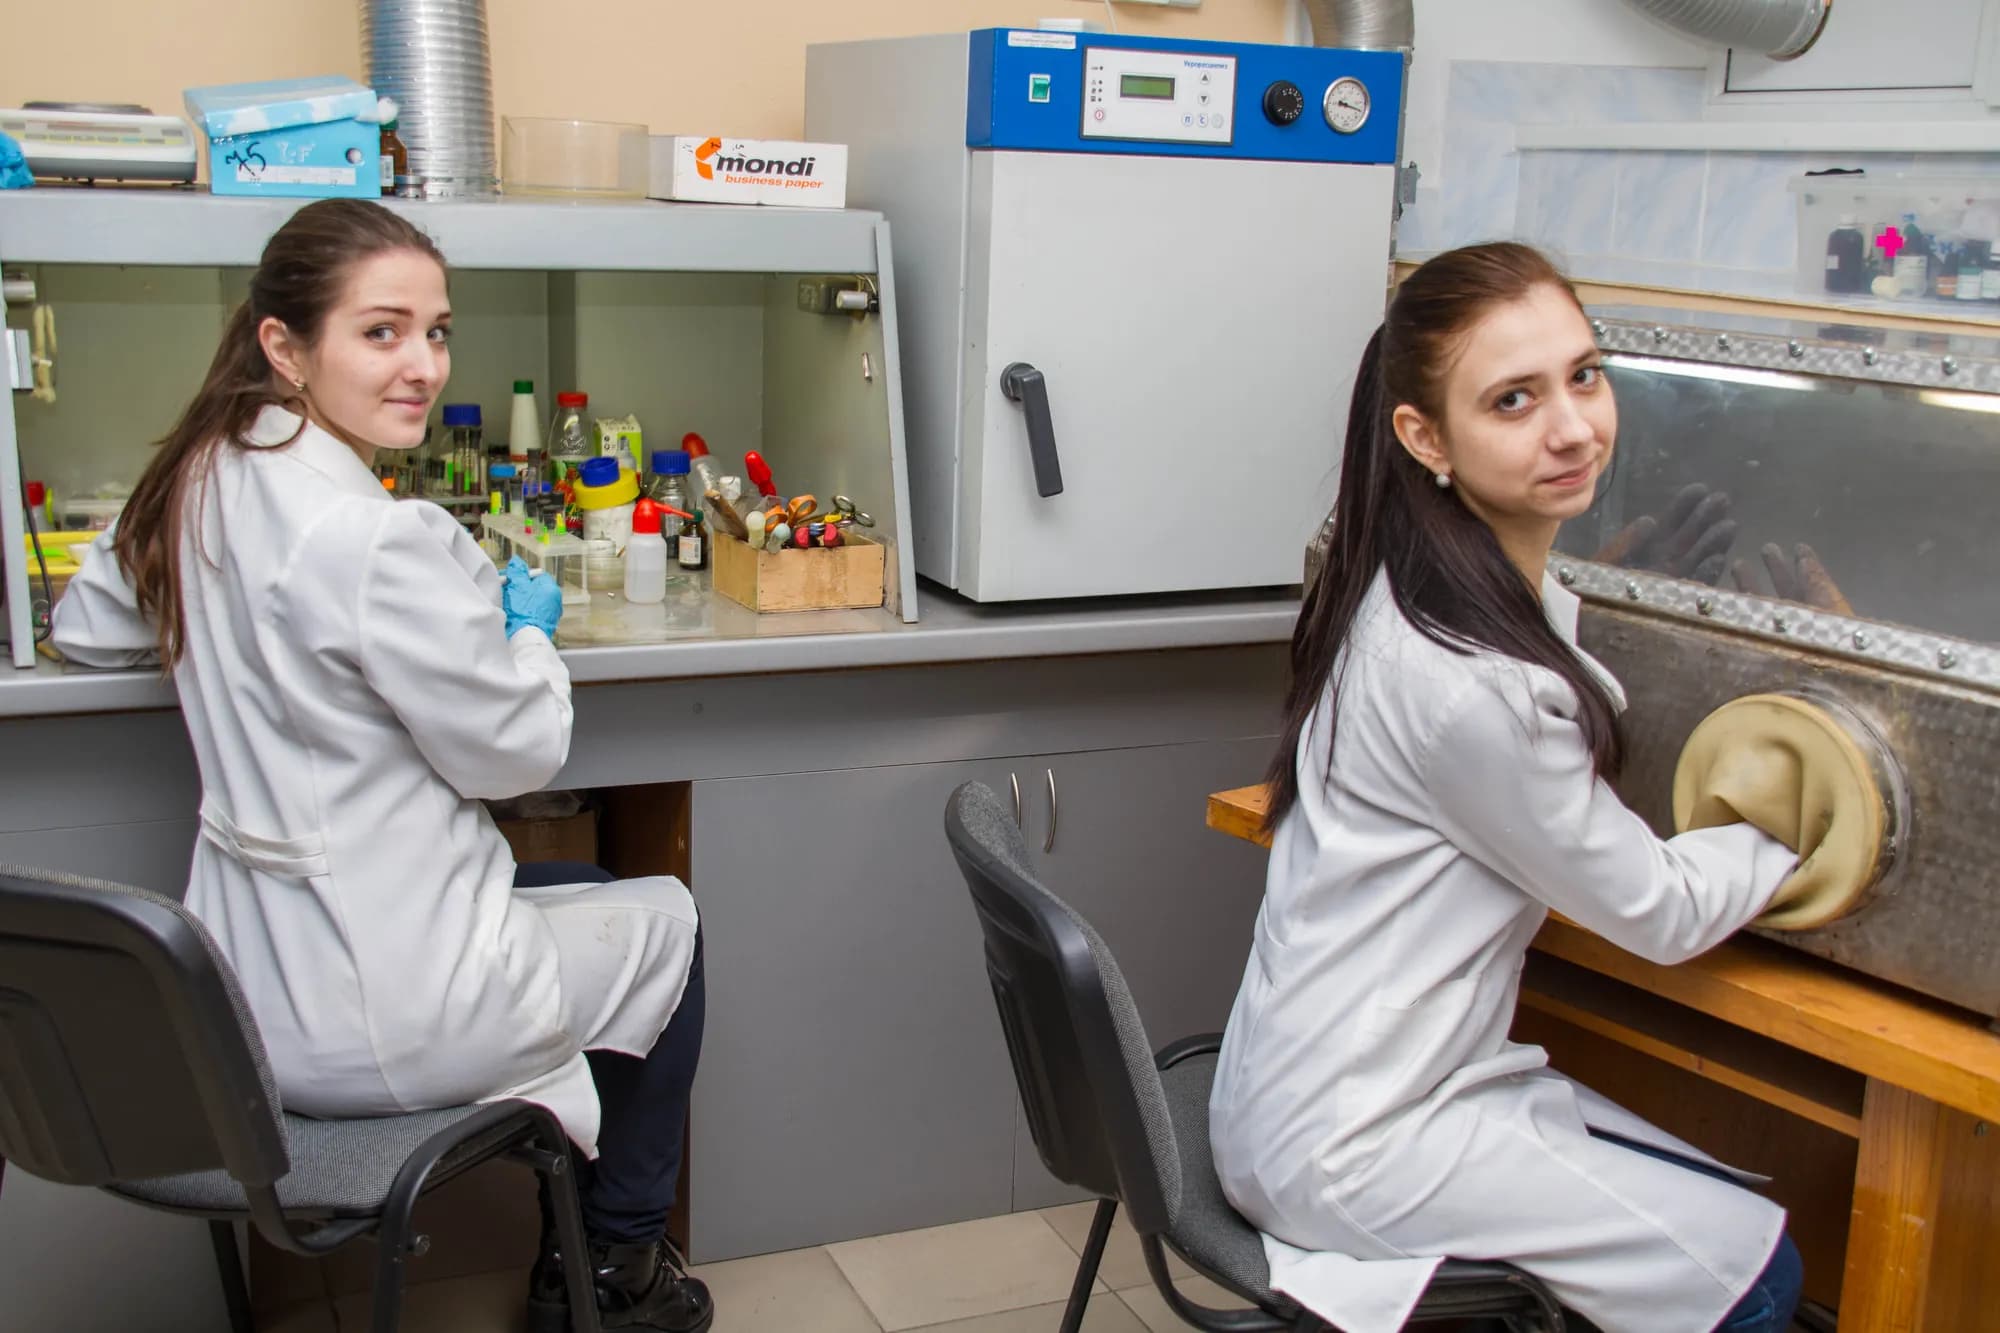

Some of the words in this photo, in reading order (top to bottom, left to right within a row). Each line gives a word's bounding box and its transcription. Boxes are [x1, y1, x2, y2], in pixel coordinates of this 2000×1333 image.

[716, 156, 816, 177] mondi
[725, 174, 782, 186] business
[785, 180, 824, 189] paper
